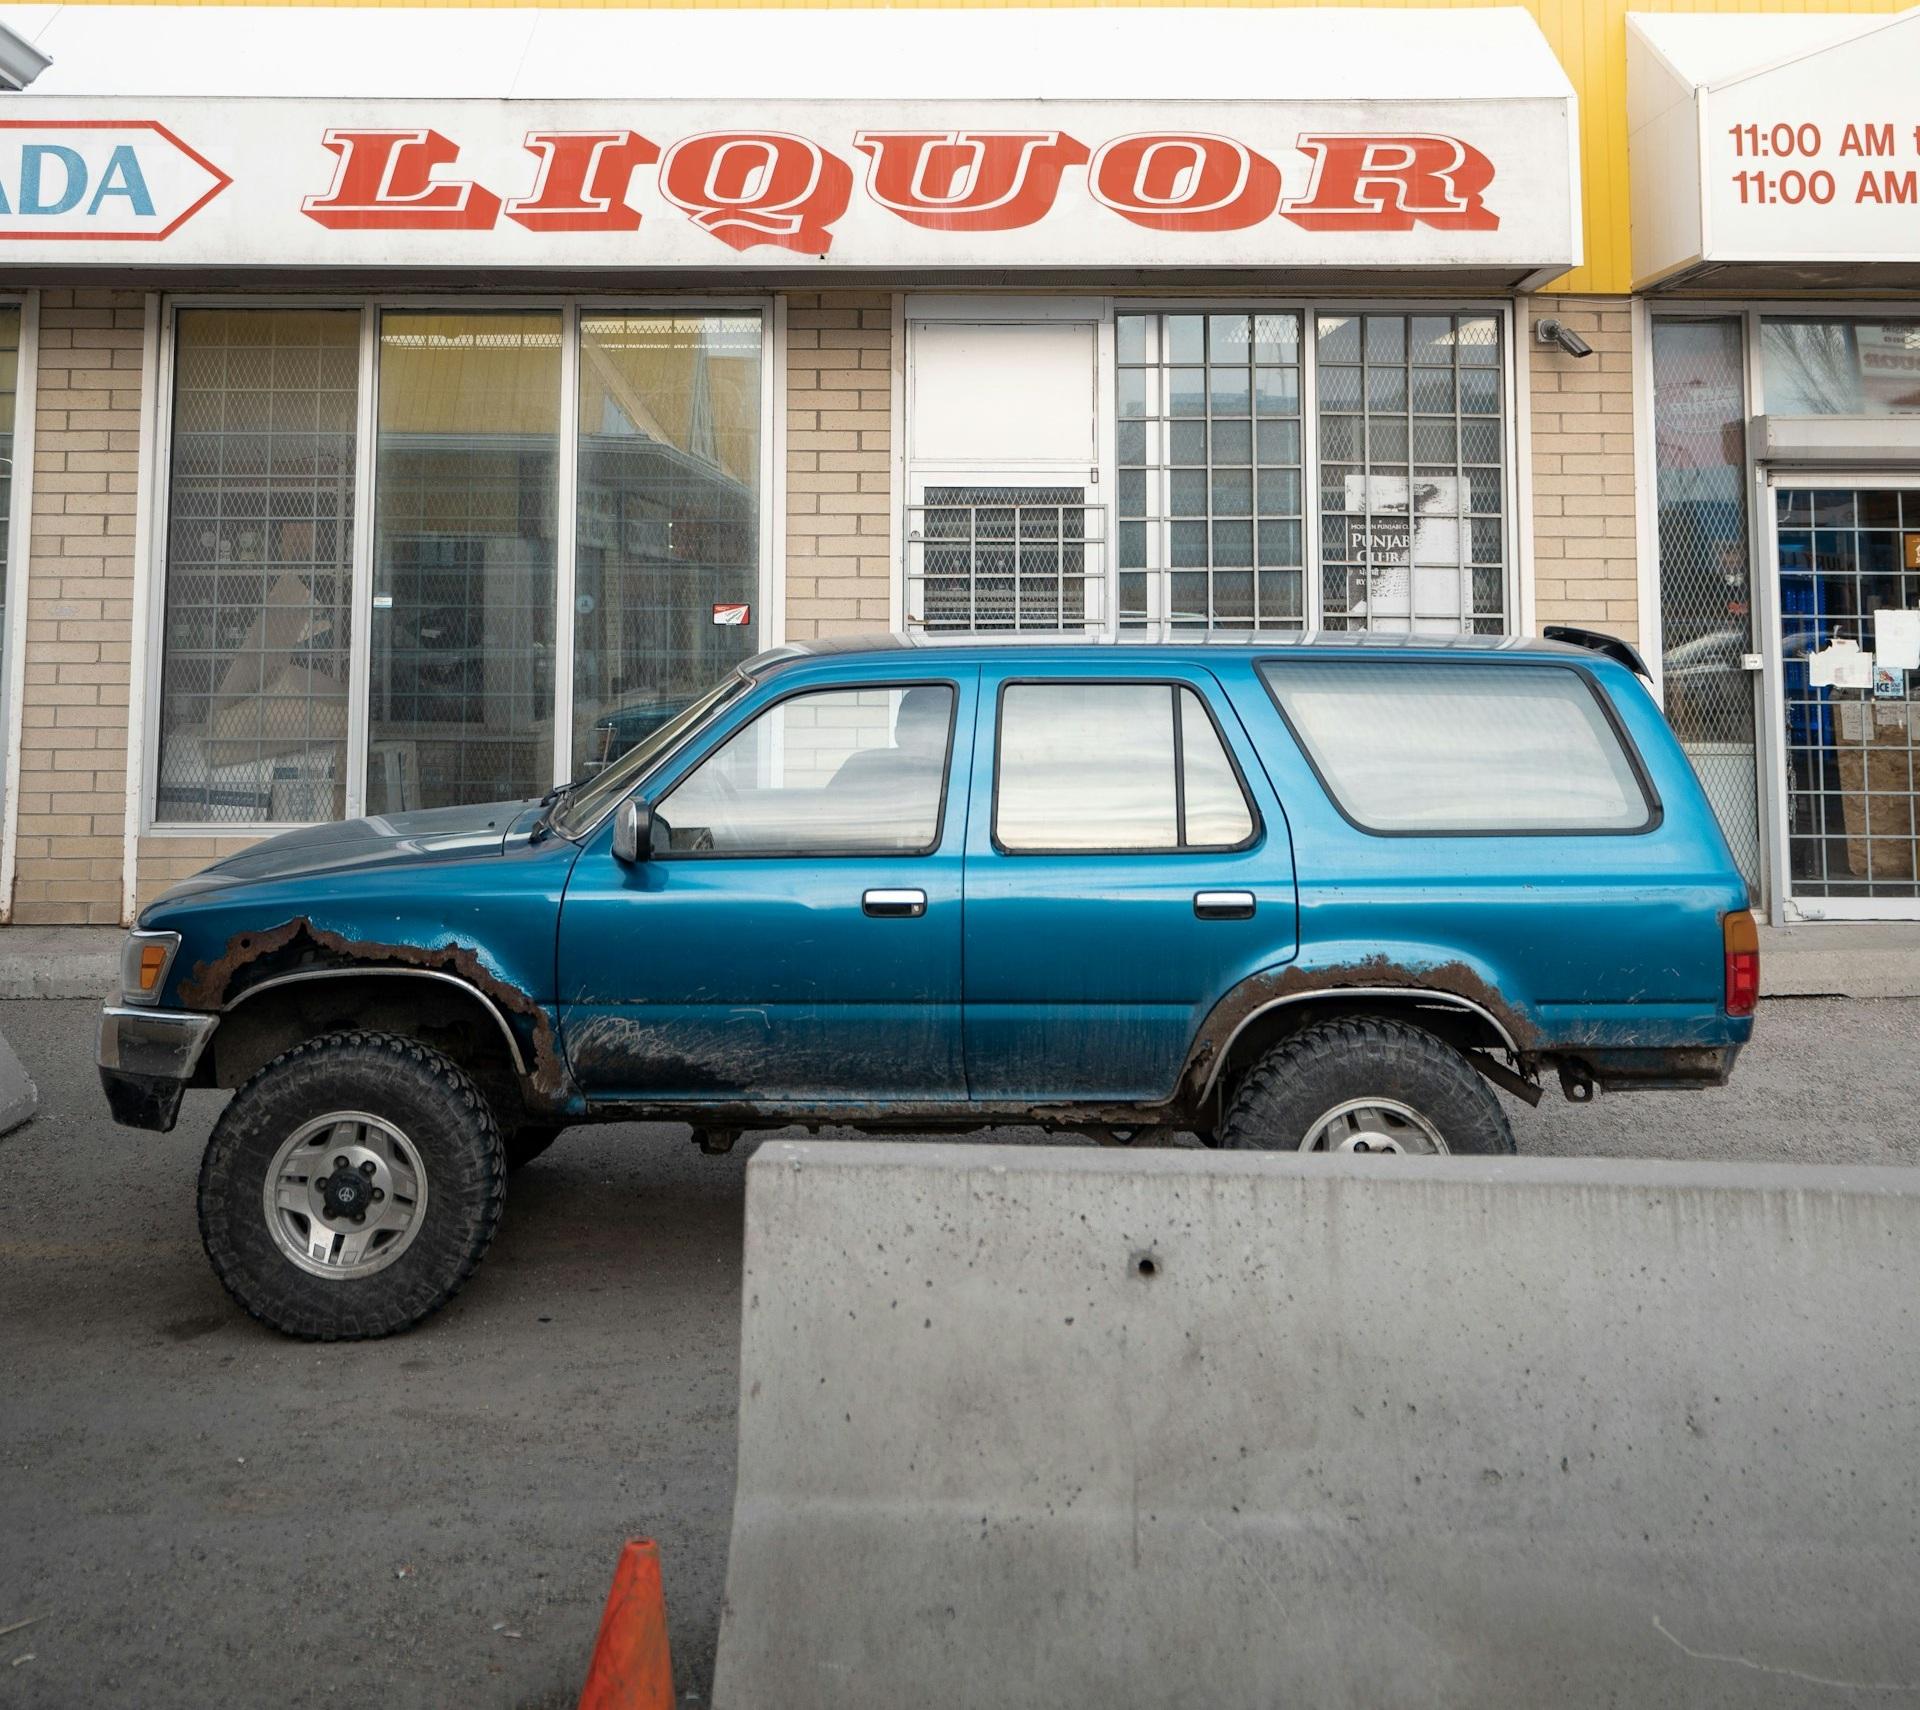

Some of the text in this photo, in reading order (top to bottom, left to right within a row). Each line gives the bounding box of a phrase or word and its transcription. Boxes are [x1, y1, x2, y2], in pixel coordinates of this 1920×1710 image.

[1729, 122, 1821, 158] 11:00
[1839, 122, 1896, 157] AM
[0, 144, 157, 216] DA
[300, 128, 1500, 254] LIQUOR
[1732, 169, 1918, 205] 11:00 AM
[1351, 533, 1414, 551] PUNJAB
[1876, 682, 1890, 693] ICE
